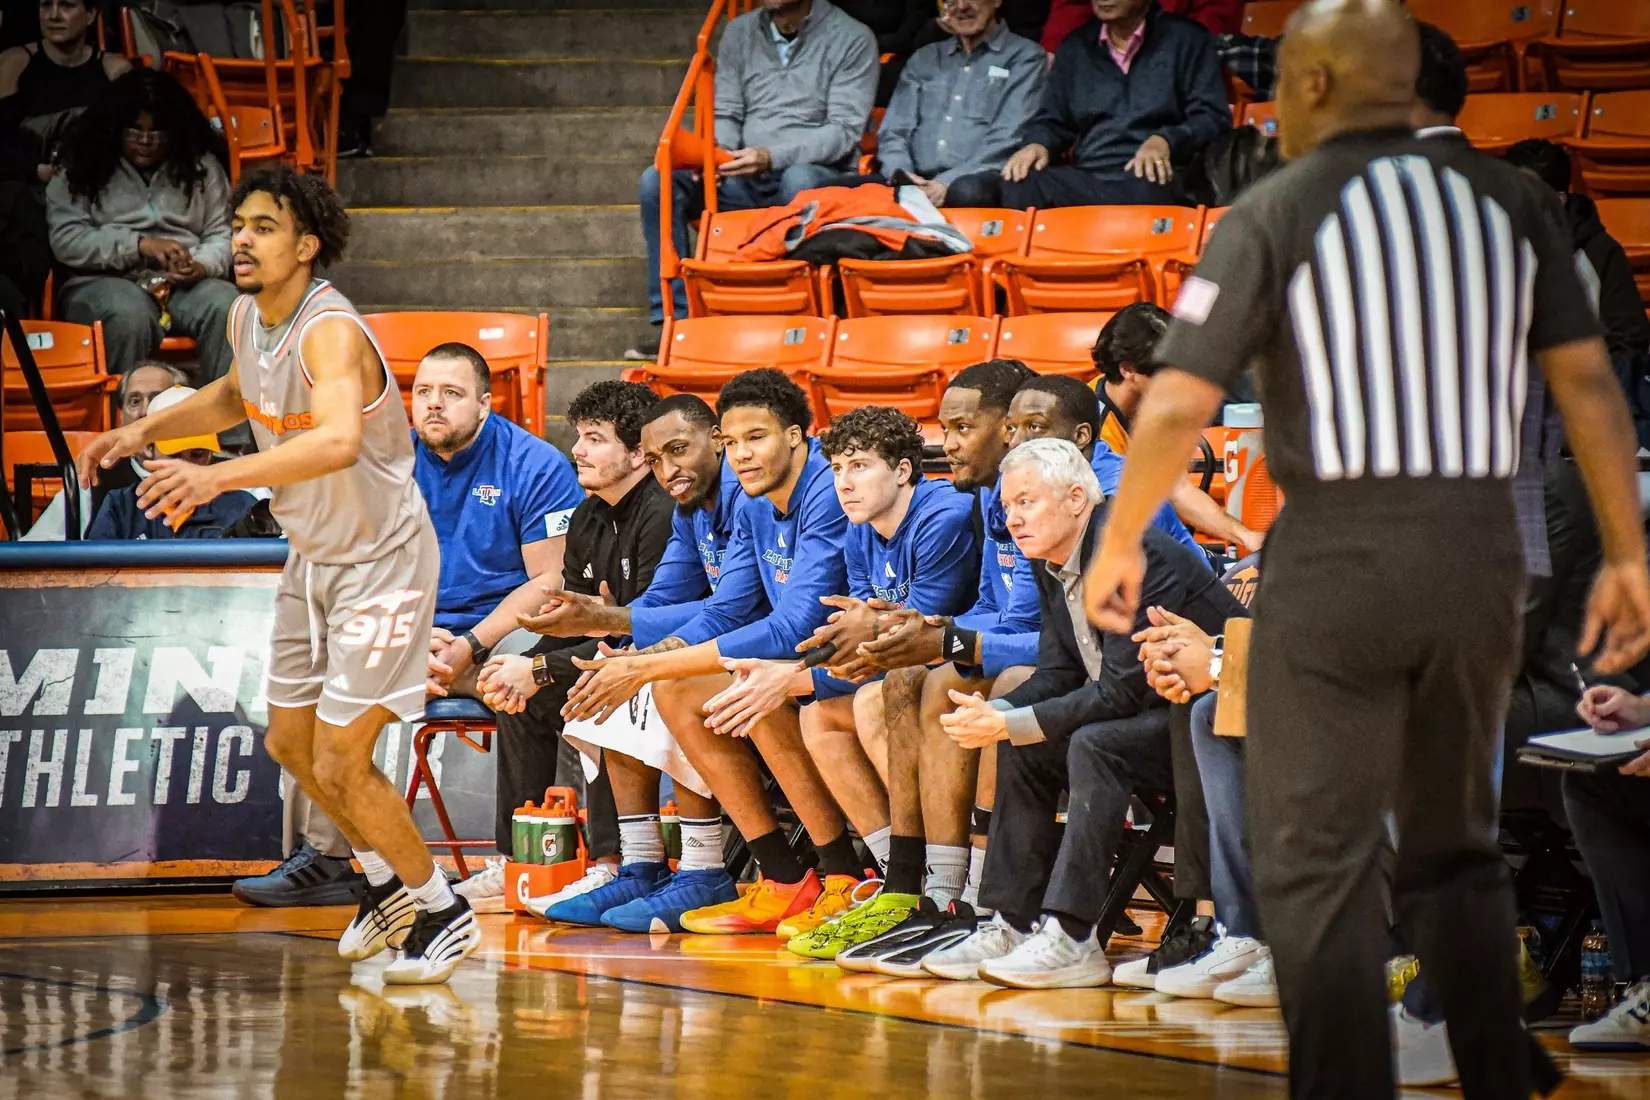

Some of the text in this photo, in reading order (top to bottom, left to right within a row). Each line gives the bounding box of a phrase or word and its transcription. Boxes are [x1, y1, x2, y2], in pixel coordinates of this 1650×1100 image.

[1223, 440, 1239, 483] G
[0, 647, 269, 717] MIN
[541, 833, 558, 858] G
[517, 872, 530, 905] G
